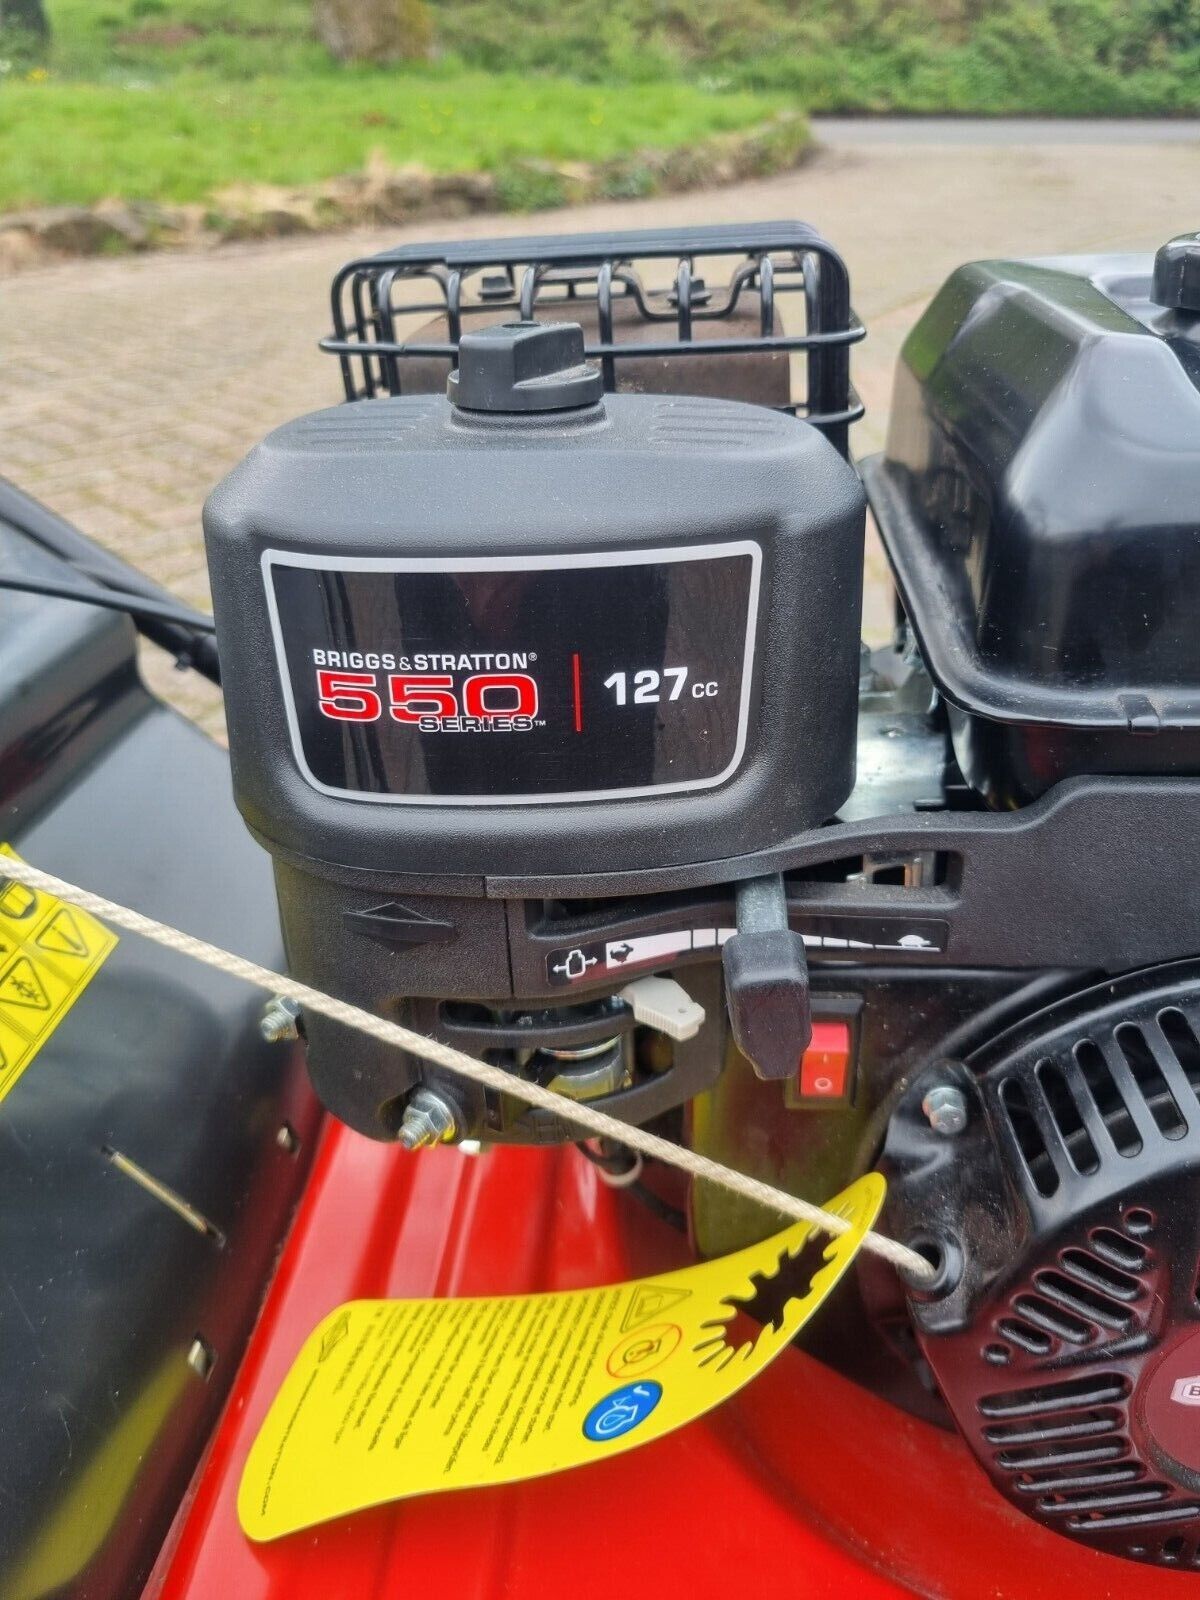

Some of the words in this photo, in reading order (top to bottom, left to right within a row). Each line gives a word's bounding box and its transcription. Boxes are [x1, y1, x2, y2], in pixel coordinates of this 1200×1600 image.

[313, 648, 396, 670] BRIGGS
[399, 656, 413, 671] &
[316, 669, 538, 724] 550
[603, 666, 688, 706] 127
